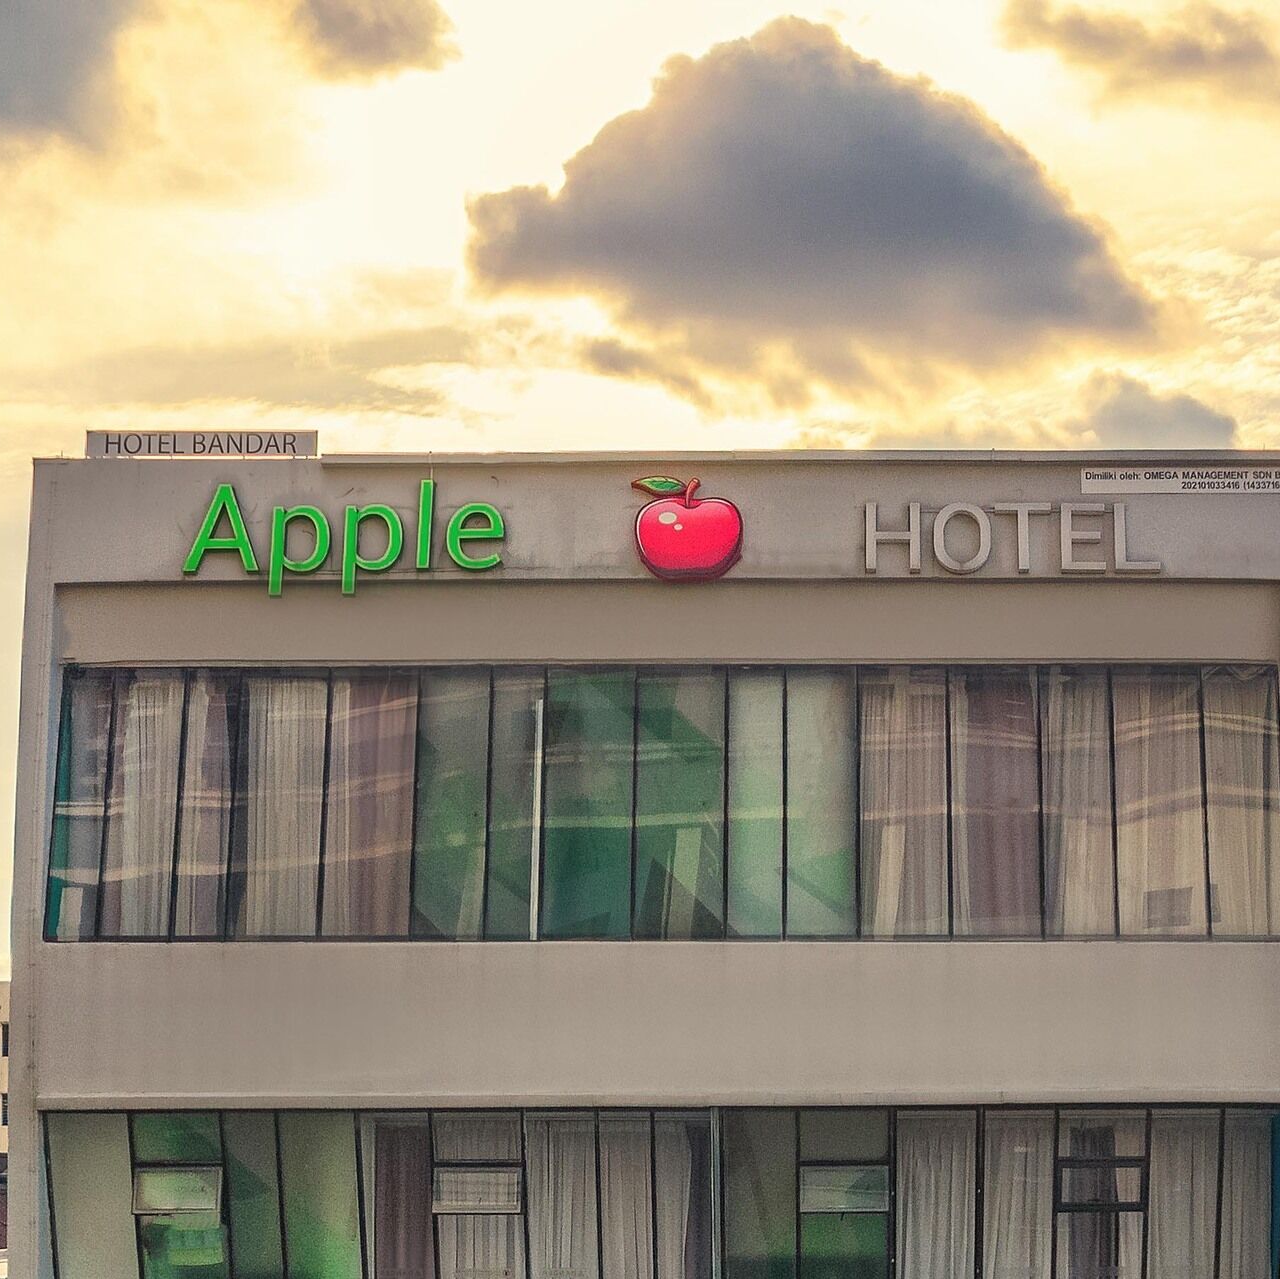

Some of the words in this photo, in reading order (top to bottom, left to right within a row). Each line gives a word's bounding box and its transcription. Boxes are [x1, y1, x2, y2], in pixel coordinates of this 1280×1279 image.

[104, 433, 185, 454] HOTEL
[192, 433, 298, 454] BANDAR
[1085, 471, 1117, 480] Dimiliki
[1119, 471, 1141, 480] oleh:
[1143, 471, 1179, 480] OMEGA
[1182, 471, 1249, 480] MANAGEMENT
[1252, 471, 1272, 480] SDN
[182, 479, 506, 597] Apple
[864, 501, 1162, 576] HOTEL
